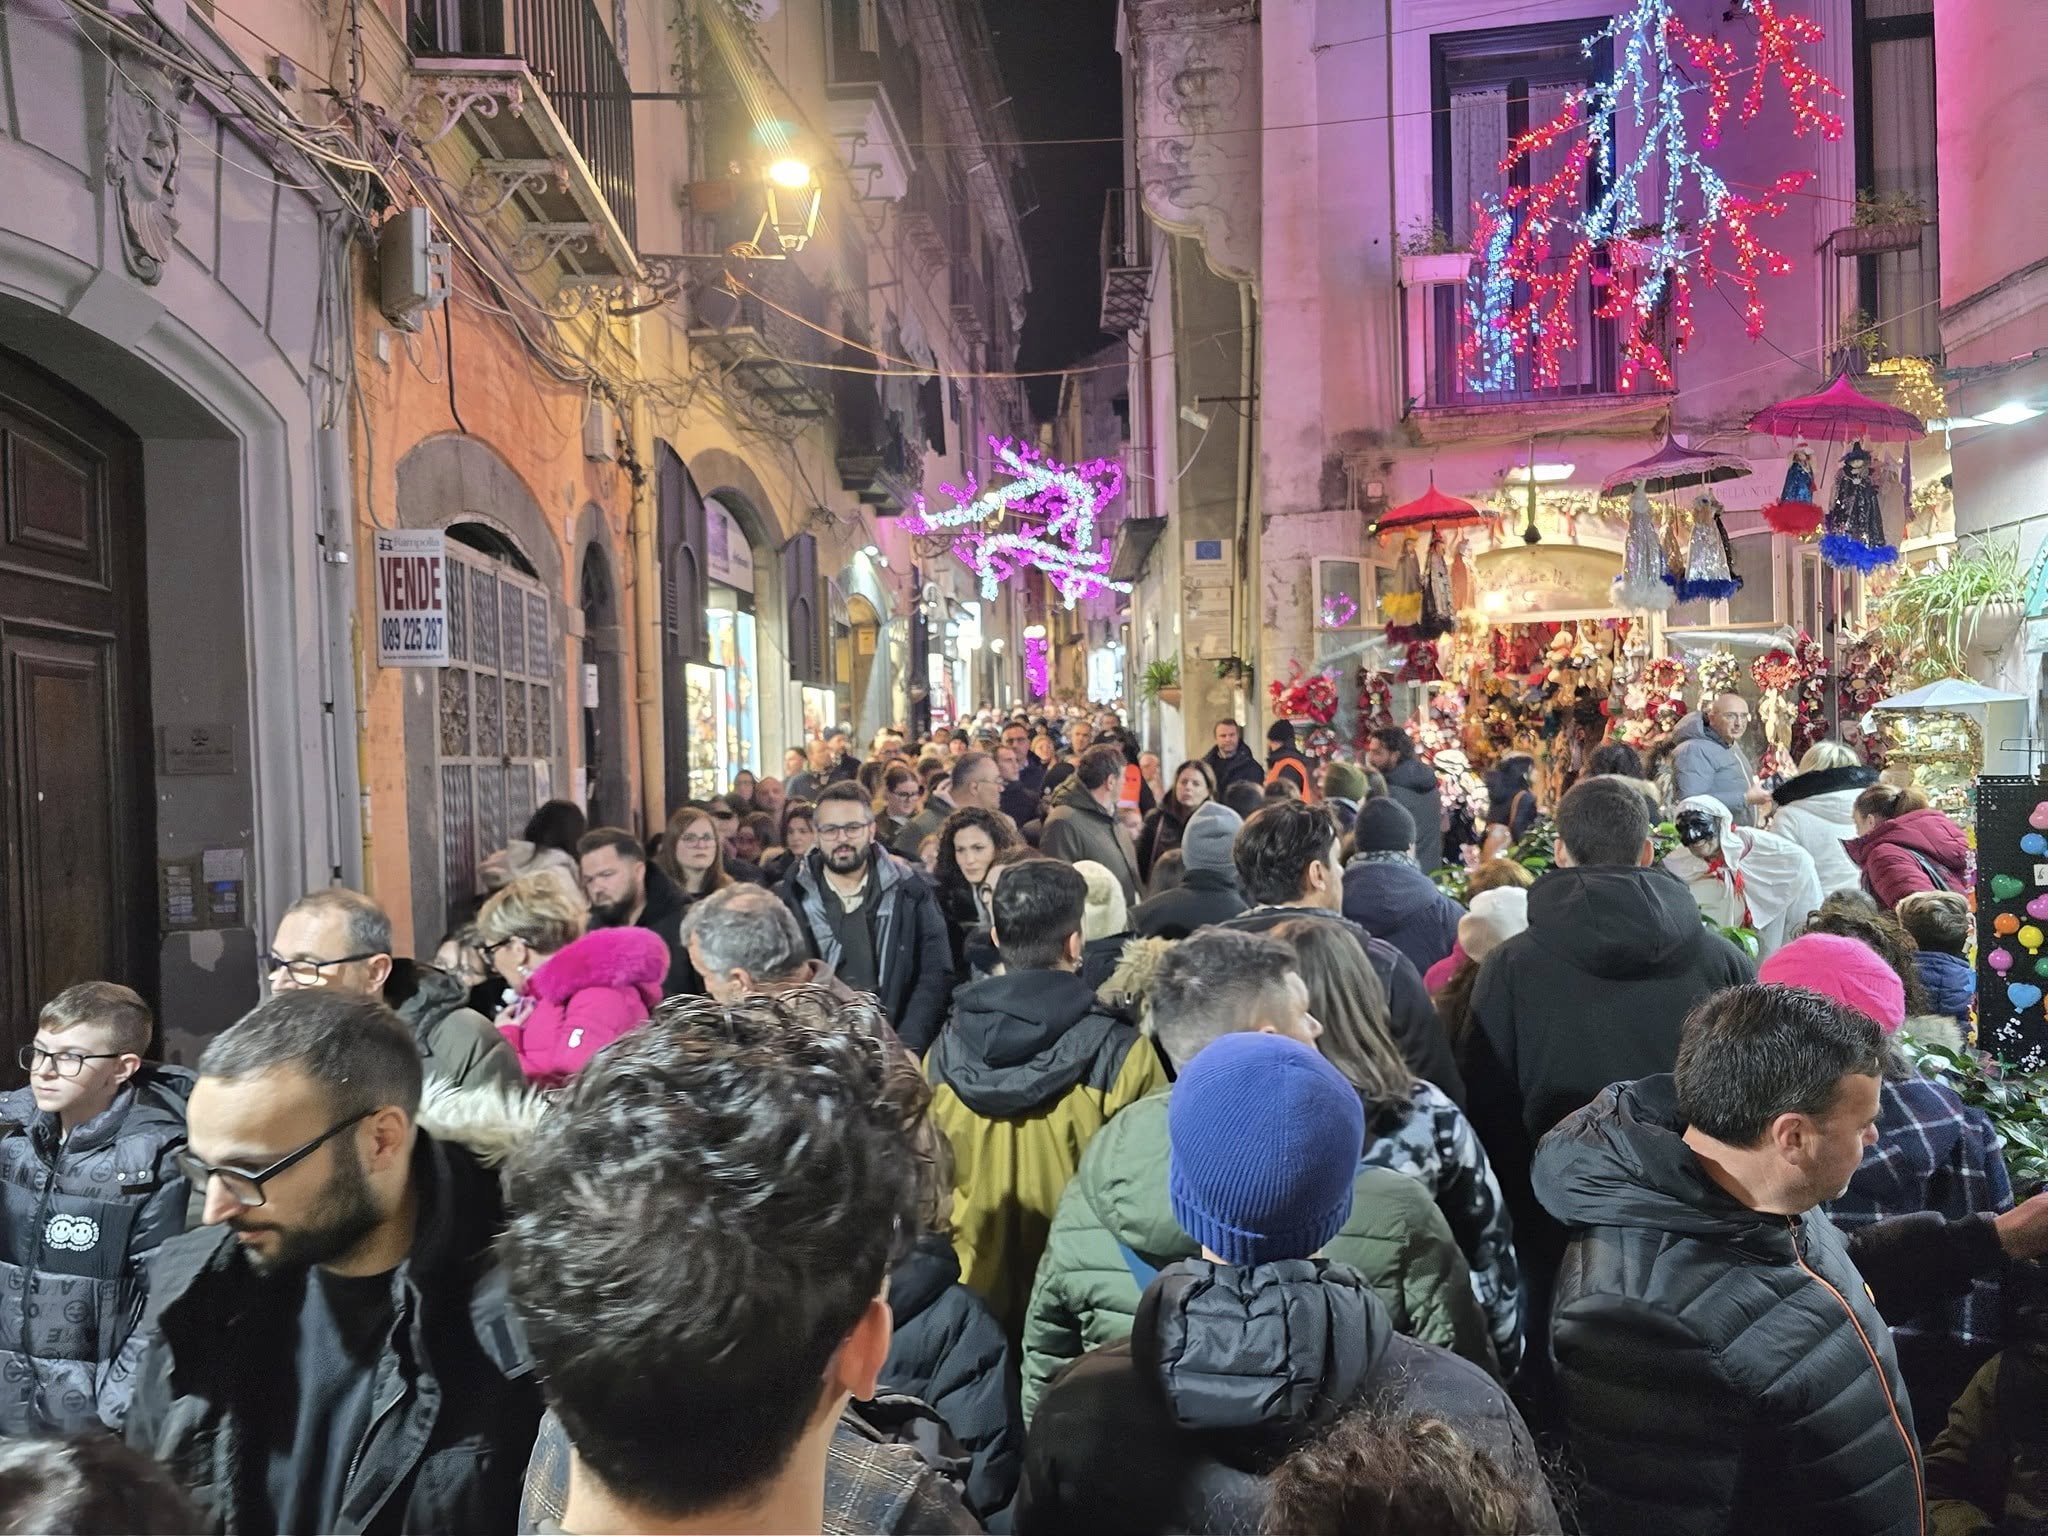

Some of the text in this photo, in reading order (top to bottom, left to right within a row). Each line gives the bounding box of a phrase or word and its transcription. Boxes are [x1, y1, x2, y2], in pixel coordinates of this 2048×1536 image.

[380, 557, 442, 611] VENDE
[382, 618, 443, 651] 089 225 287
